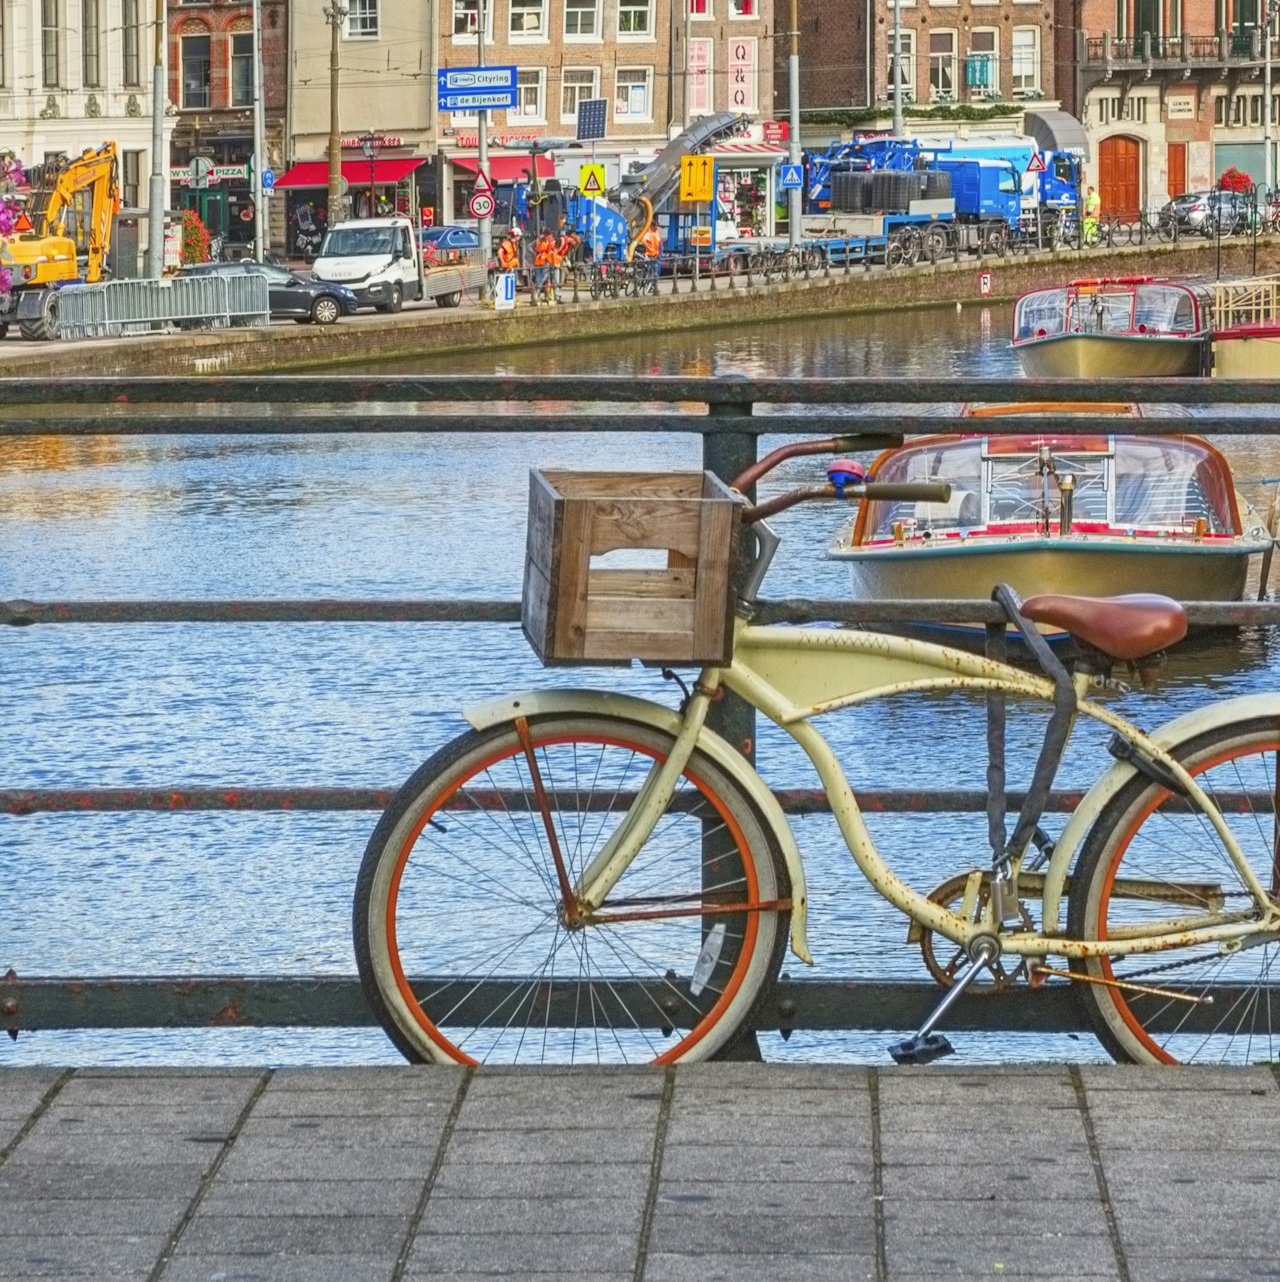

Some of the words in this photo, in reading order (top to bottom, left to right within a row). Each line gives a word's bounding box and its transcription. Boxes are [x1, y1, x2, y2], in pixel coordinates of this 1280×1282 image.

[477, 75, 509, 83] Cityring
[472, 95, 508, 104] Bijenkorf
[1063, 147, 1085, 155] HOTEL
[475, 200, 489, 210] 30
